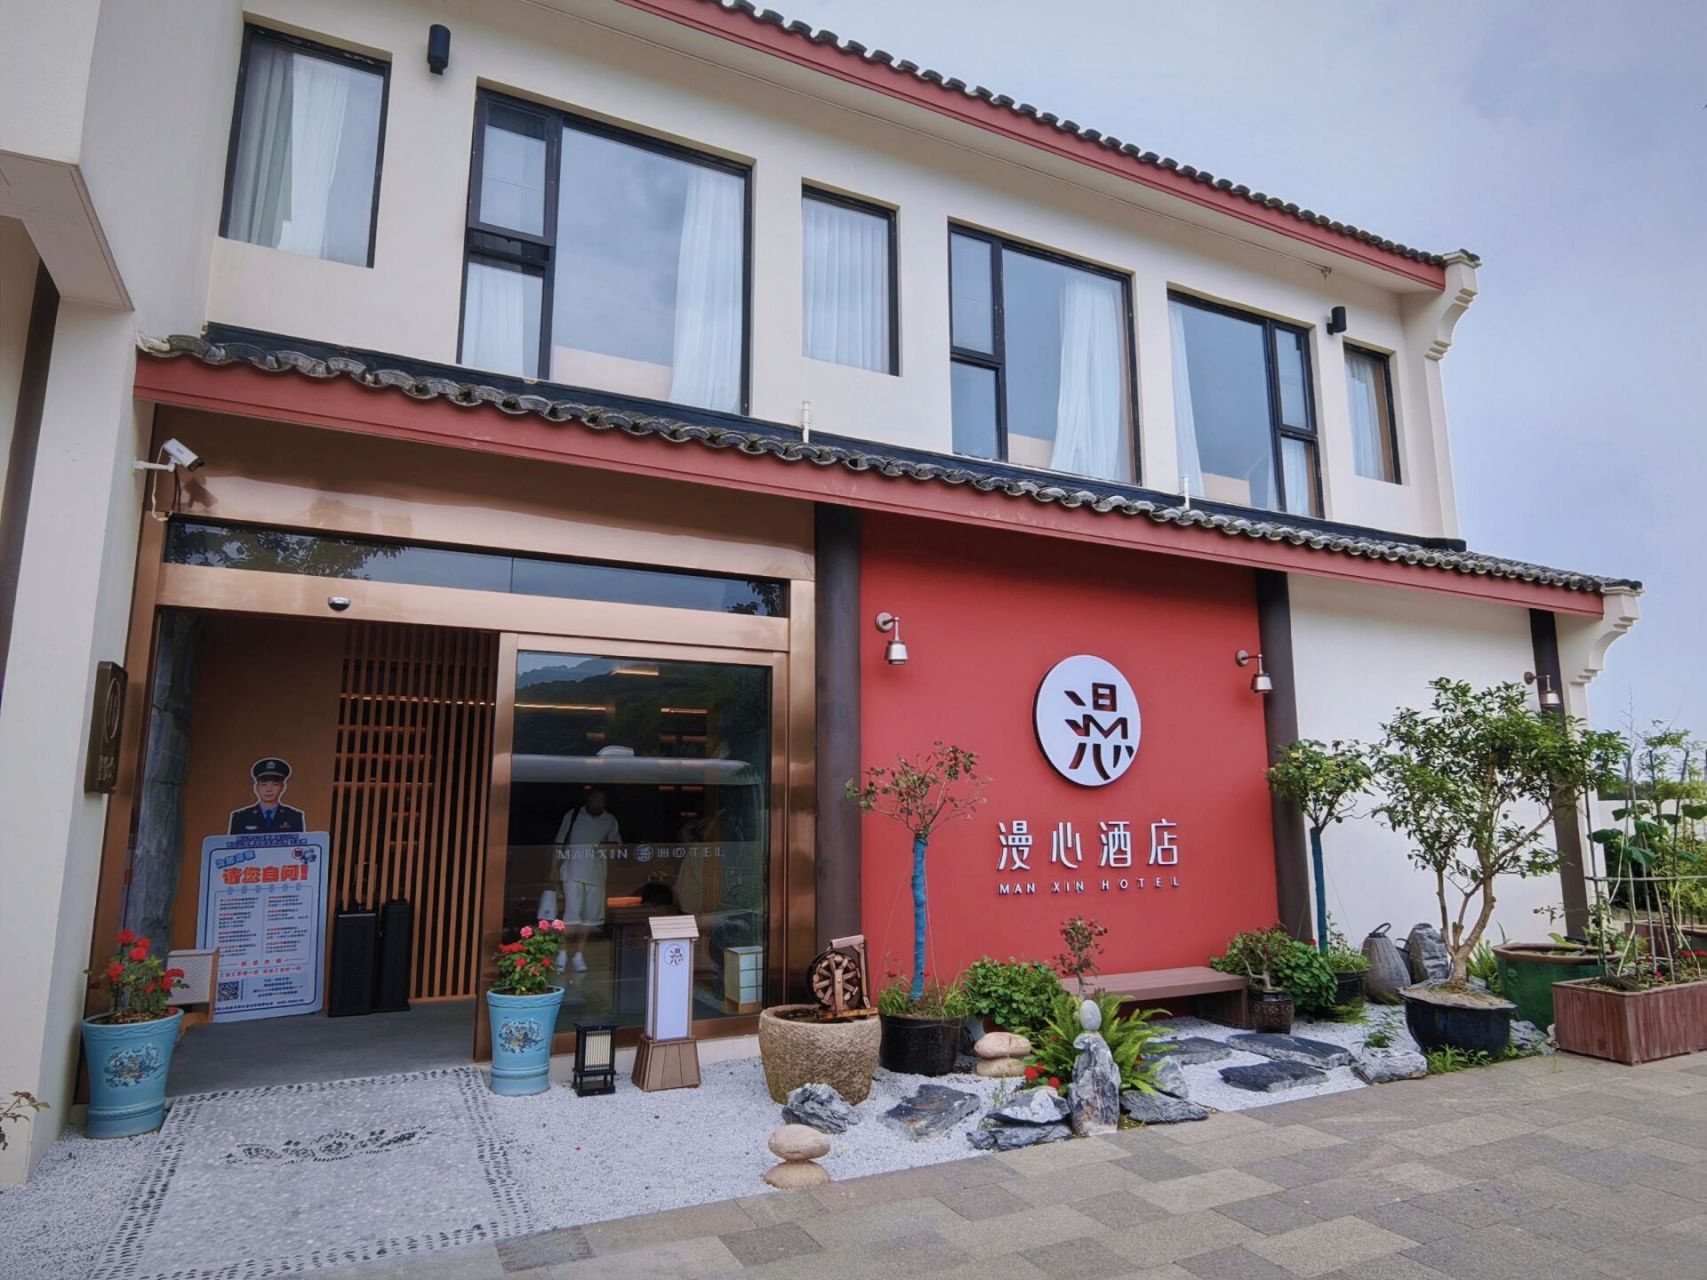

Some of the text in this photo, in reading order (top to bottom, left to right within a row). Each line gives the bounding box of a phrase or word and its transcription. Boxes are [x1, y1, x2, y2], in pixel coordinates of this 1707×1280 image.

[657, 847, 725, 859] HOTEL
[998, 818, 1179, 871] 漫心酒店
[999, 876, 1180, 895] MAN XIN HOTEL
